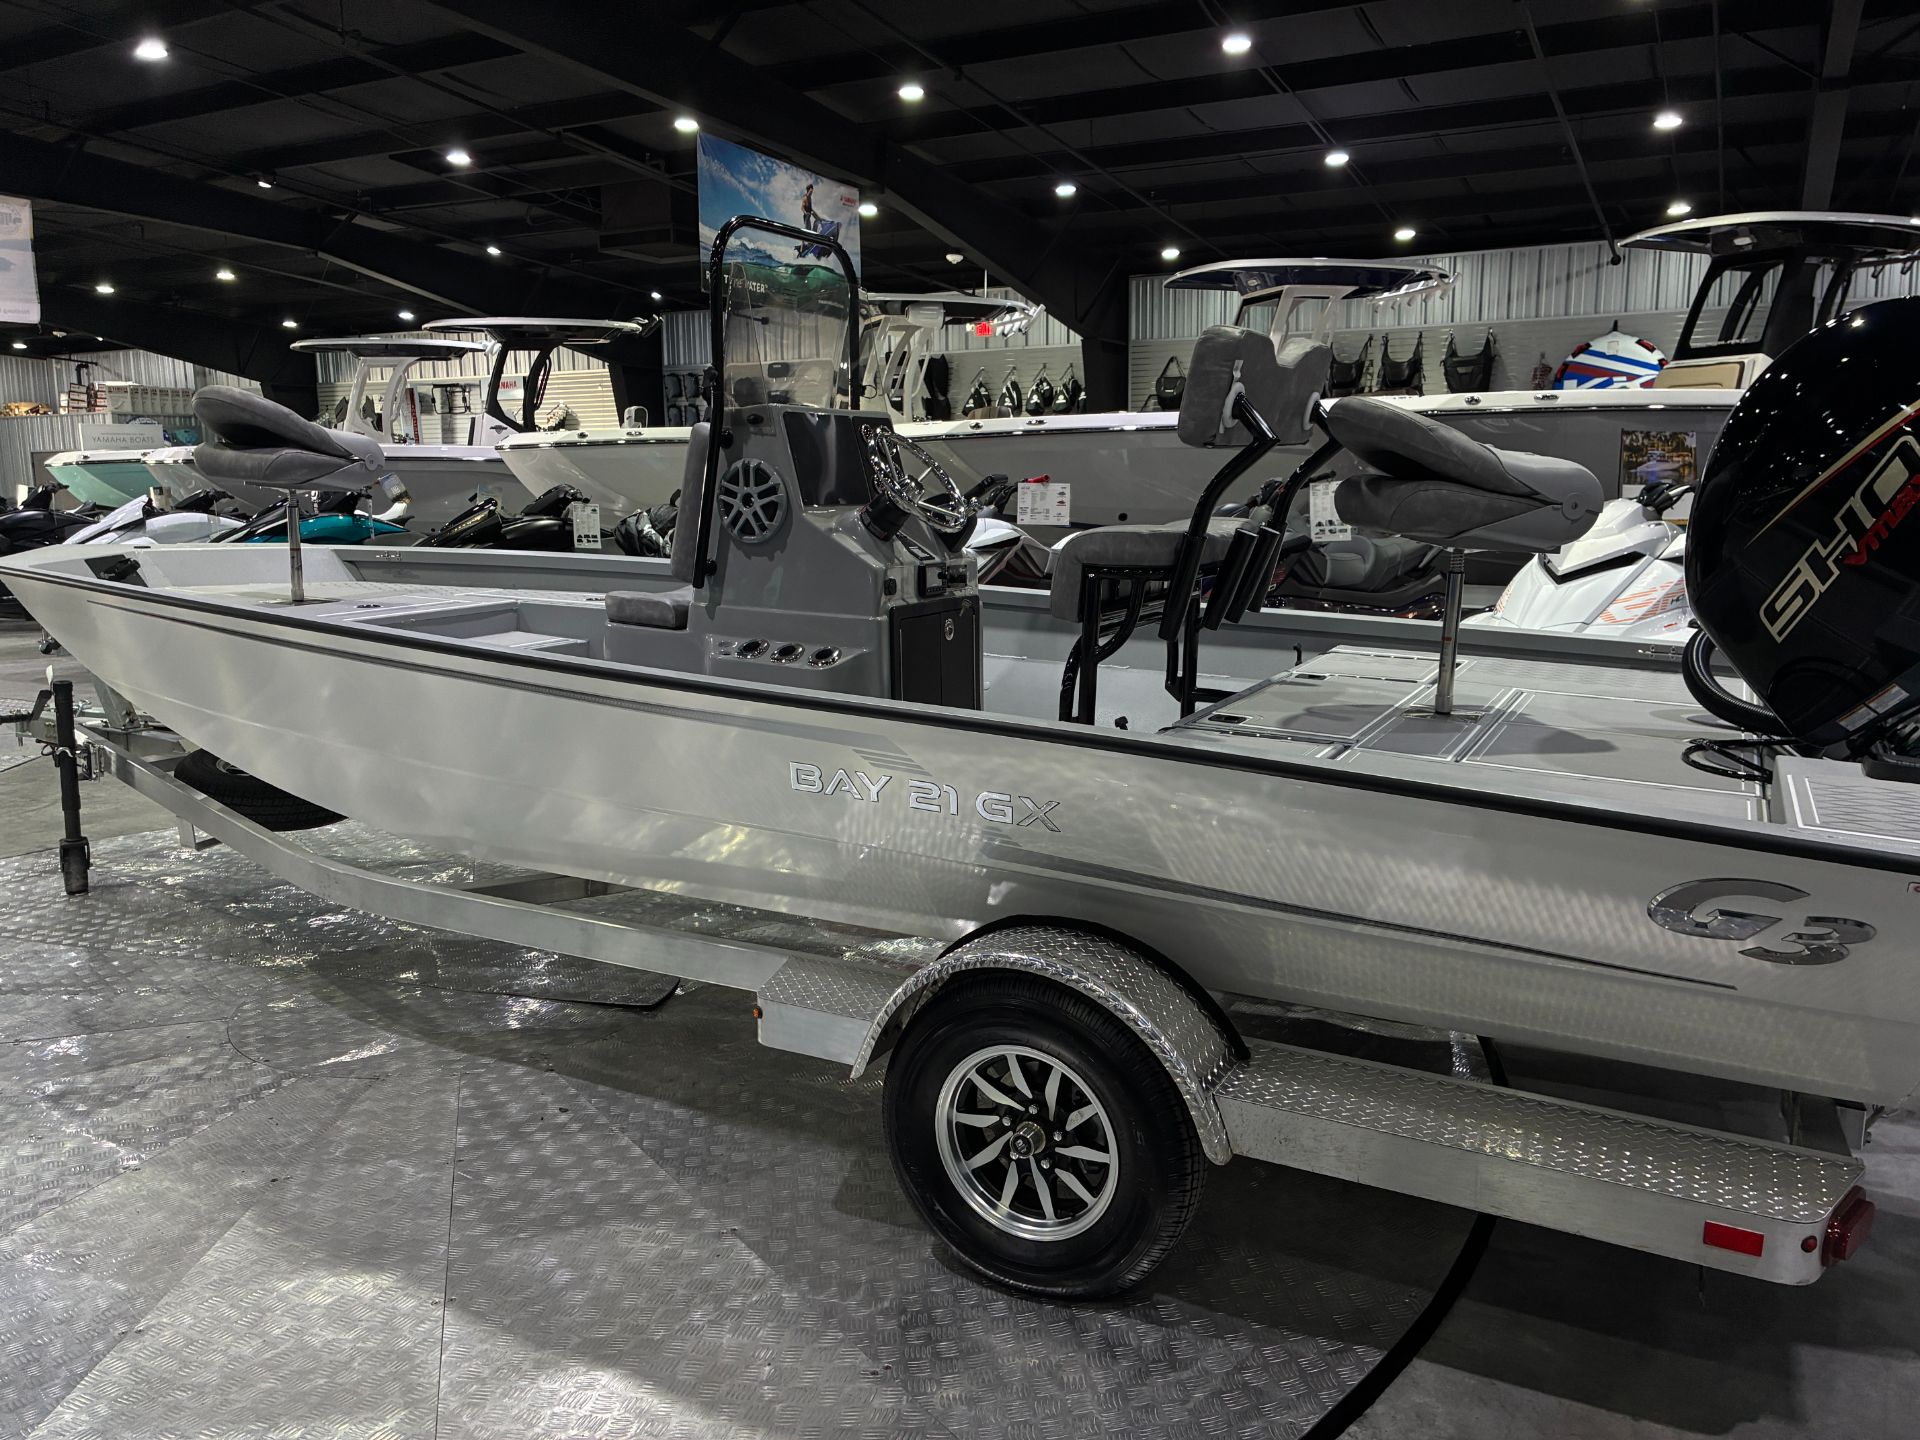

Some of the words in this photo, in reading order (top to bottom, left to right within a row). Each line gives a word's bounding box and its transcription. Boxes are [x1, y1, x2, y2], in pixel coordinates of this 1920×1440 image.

[92, 435, 127, 444] YAMAHA
[129, 436, 155, 444] BOATS
[1759, 434, 1920, 644] SHO
[789, 761, 893, 803] BAY
[908, 778, 959, 817] 21
[975, 790, 1062, 833] GX
[1646, 877, 1878, 966] G3
